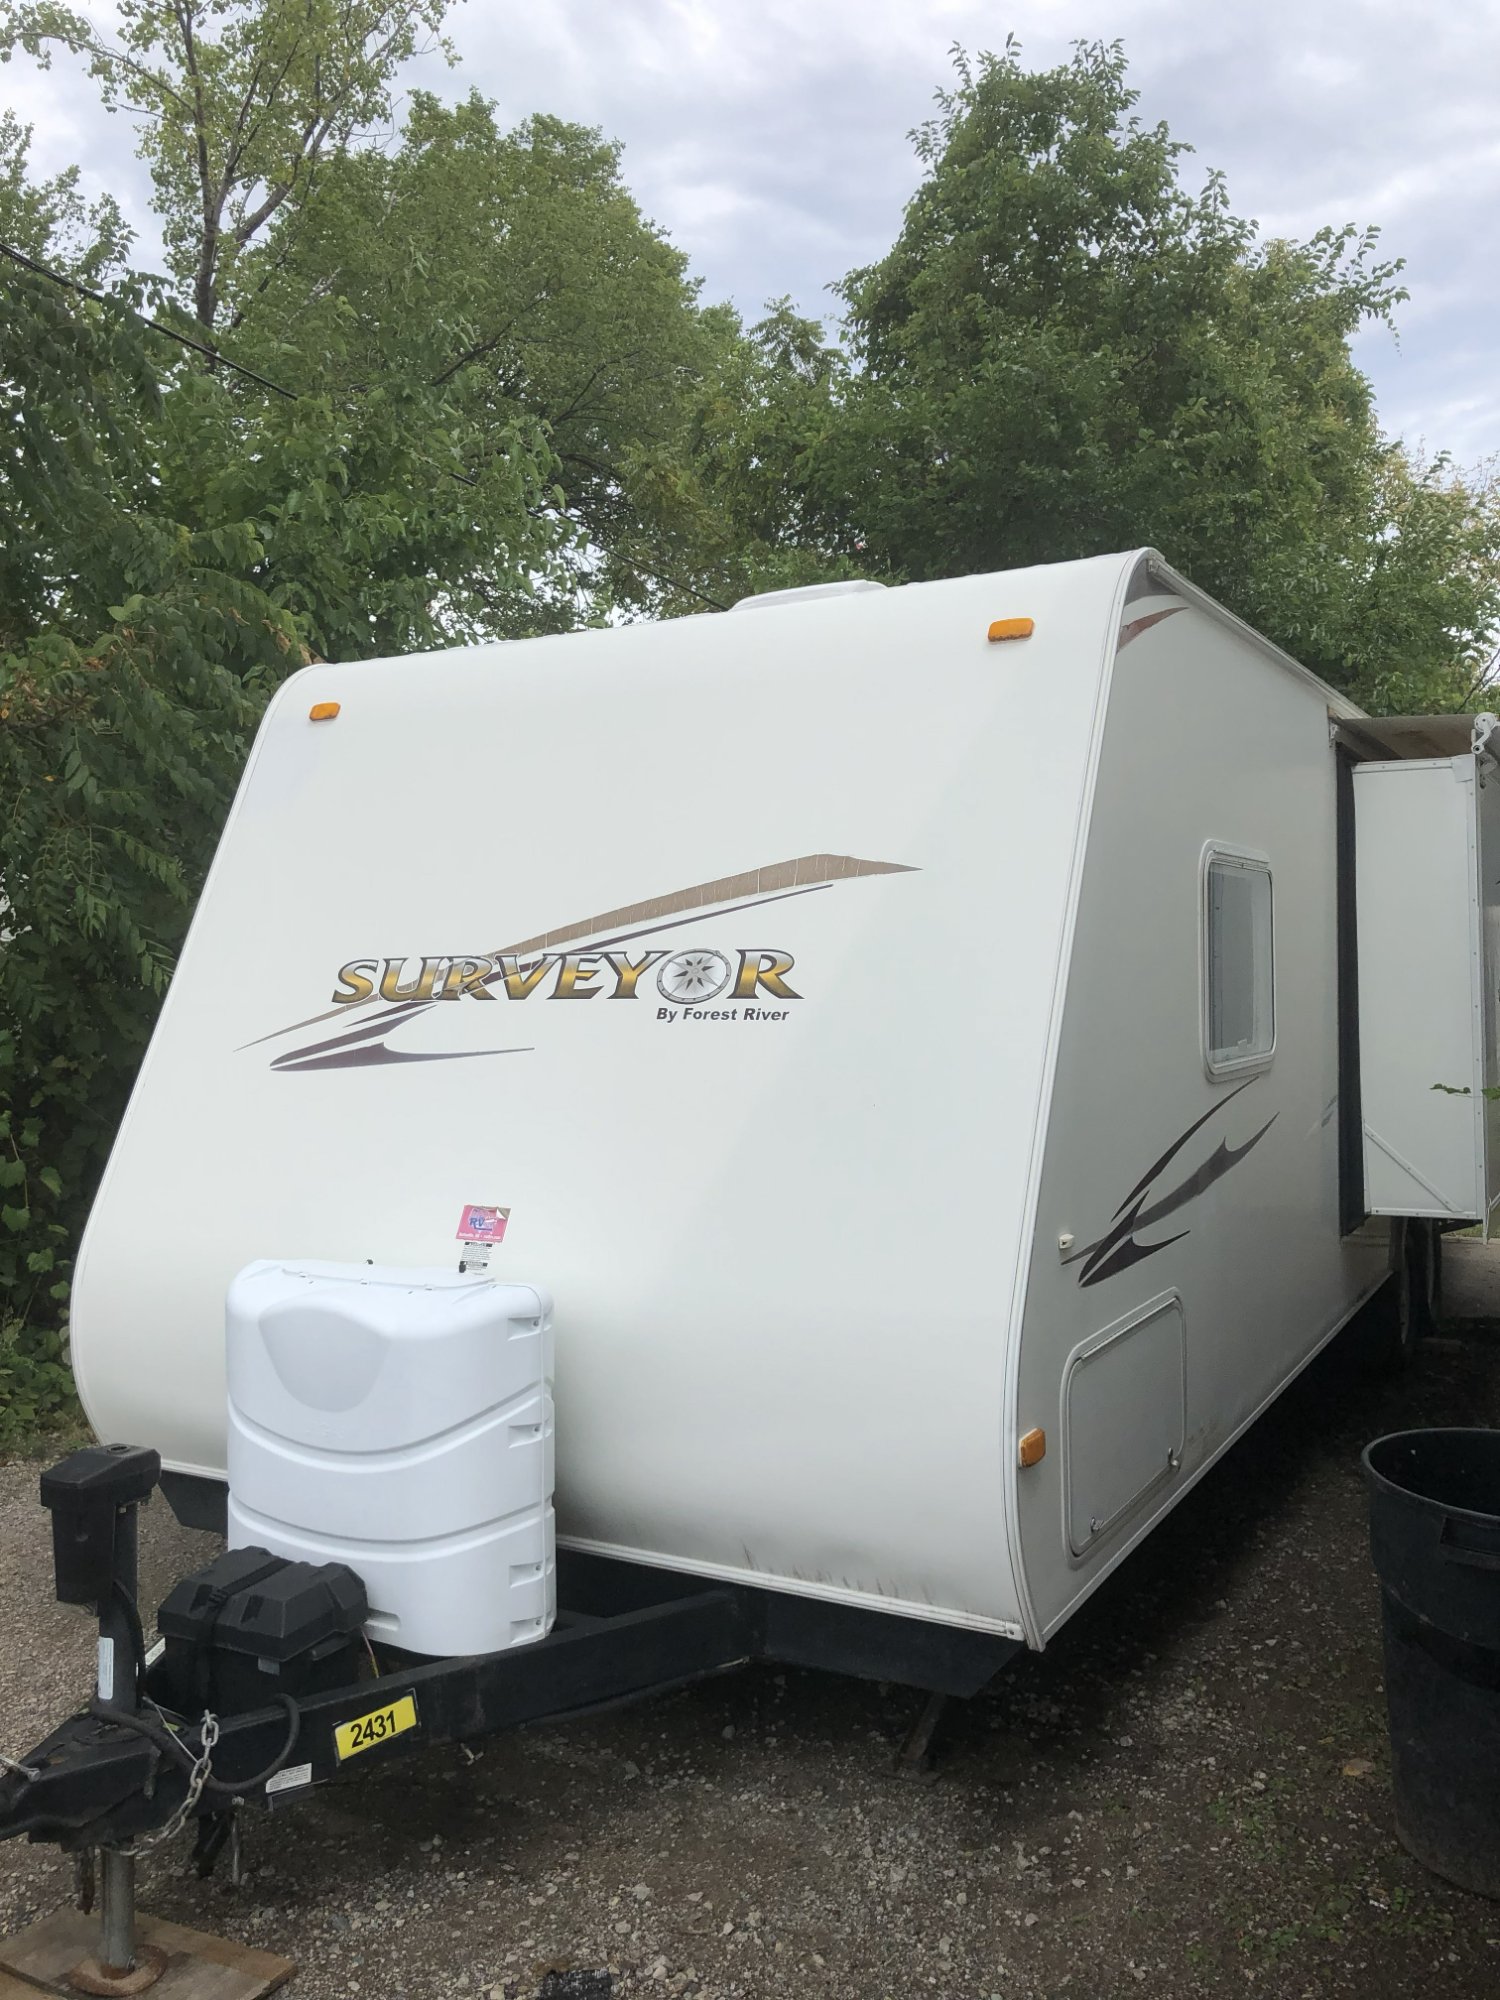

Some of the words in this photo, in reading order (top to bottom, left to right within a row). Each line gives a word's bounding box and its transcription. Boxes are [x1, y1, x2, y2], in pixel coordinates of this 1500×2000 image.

[332, 948, 805, 1004] SURVEYOR
[656, 1007, 678, 1023] By
[683, 1007, 738, 1021] Forest
[743, 1007, 790, 1021] River
[469, 1217, 486, 1229] RV
[350, 1709, 396, 1749] 2431
